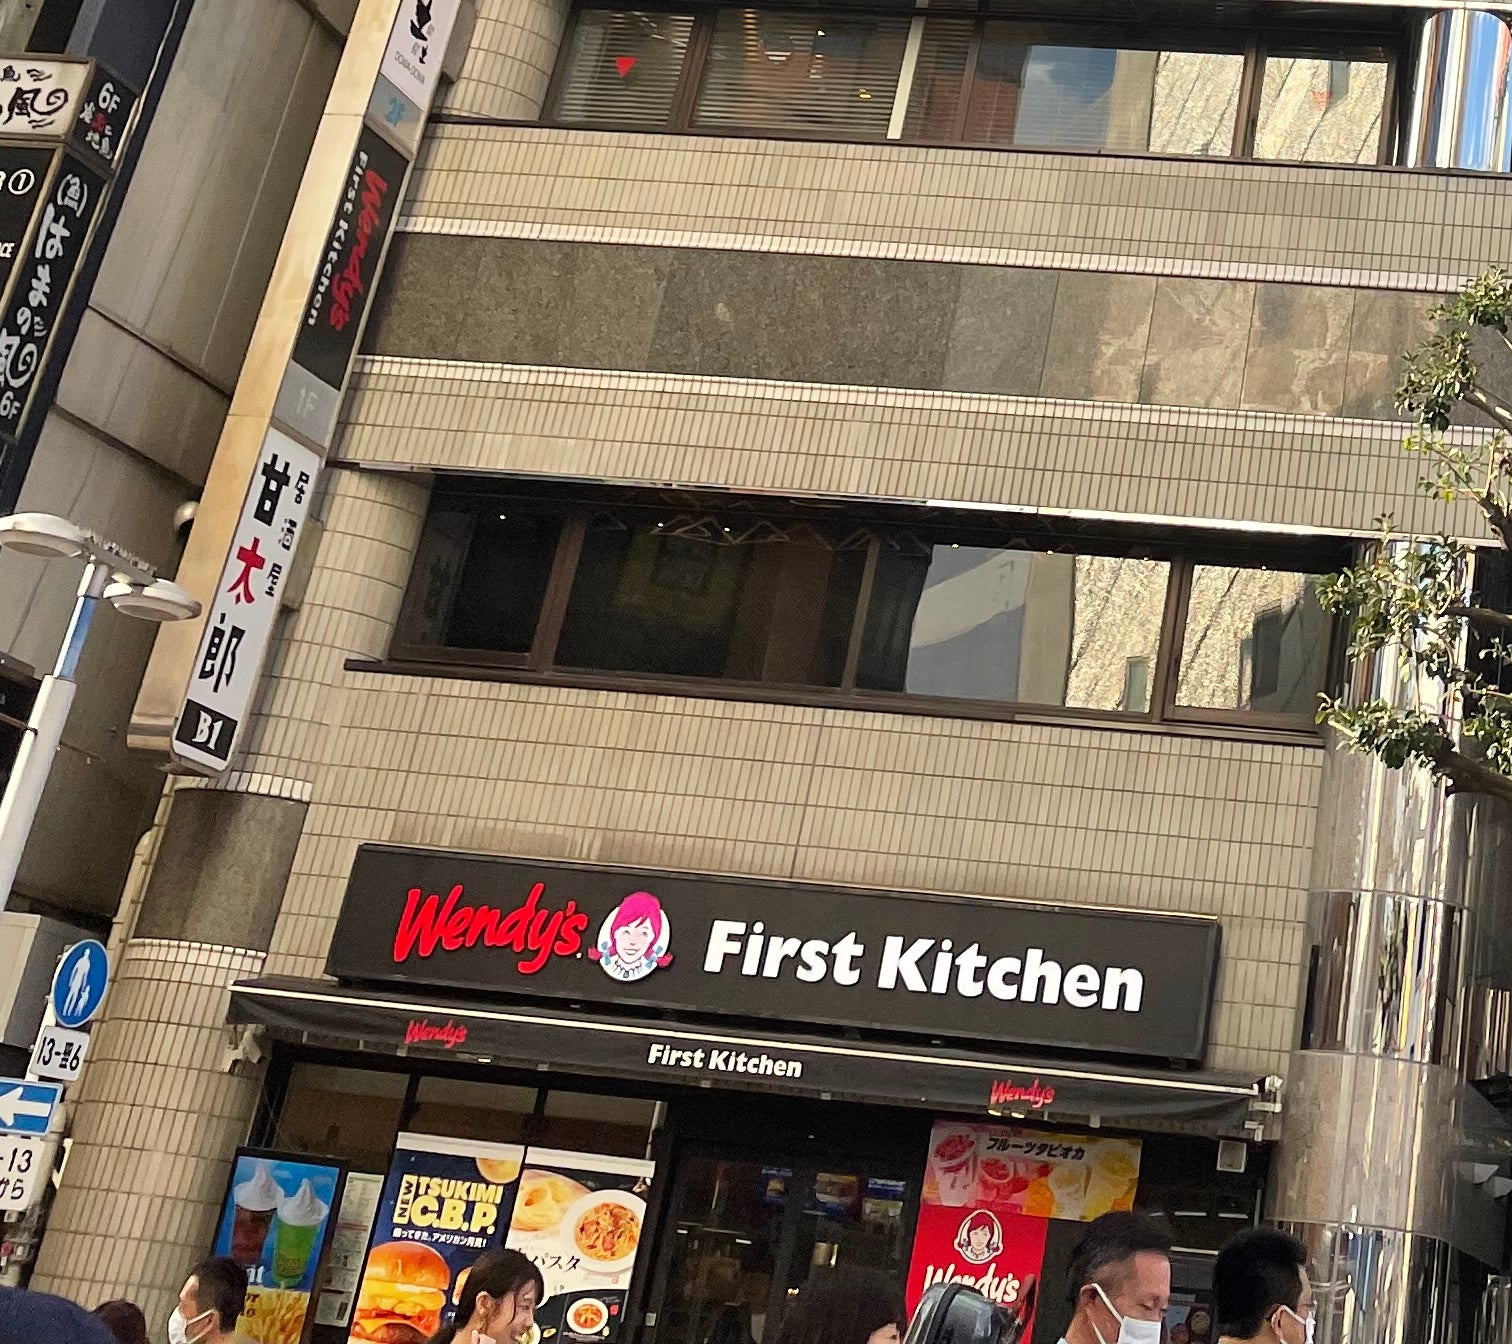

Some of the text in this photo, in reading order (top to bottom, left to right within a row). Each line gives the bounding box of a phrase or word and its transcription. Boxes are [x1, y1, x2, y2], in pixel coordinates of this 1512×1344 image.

[98, 82, 121, 114] 6F
[307, 150, 370, 327] First Kitchen
[1, 391, 21, 420] 6F
[198, 452, 292, 694] 甘太郎
[195, 709, 224, 751] B1
[393, 880, 1146, 1014] Wendy's First Kitchen
[647, 1042, 803, 1080] First Kitchen
[984, 1136, 1087, 1161] フルーツタピオカ
[397, 1179, 414, 1218] NEW
[417, 1175, 505, 1205] TSUKIMI
[410, 1193, 497, 1235] C.B.P.
